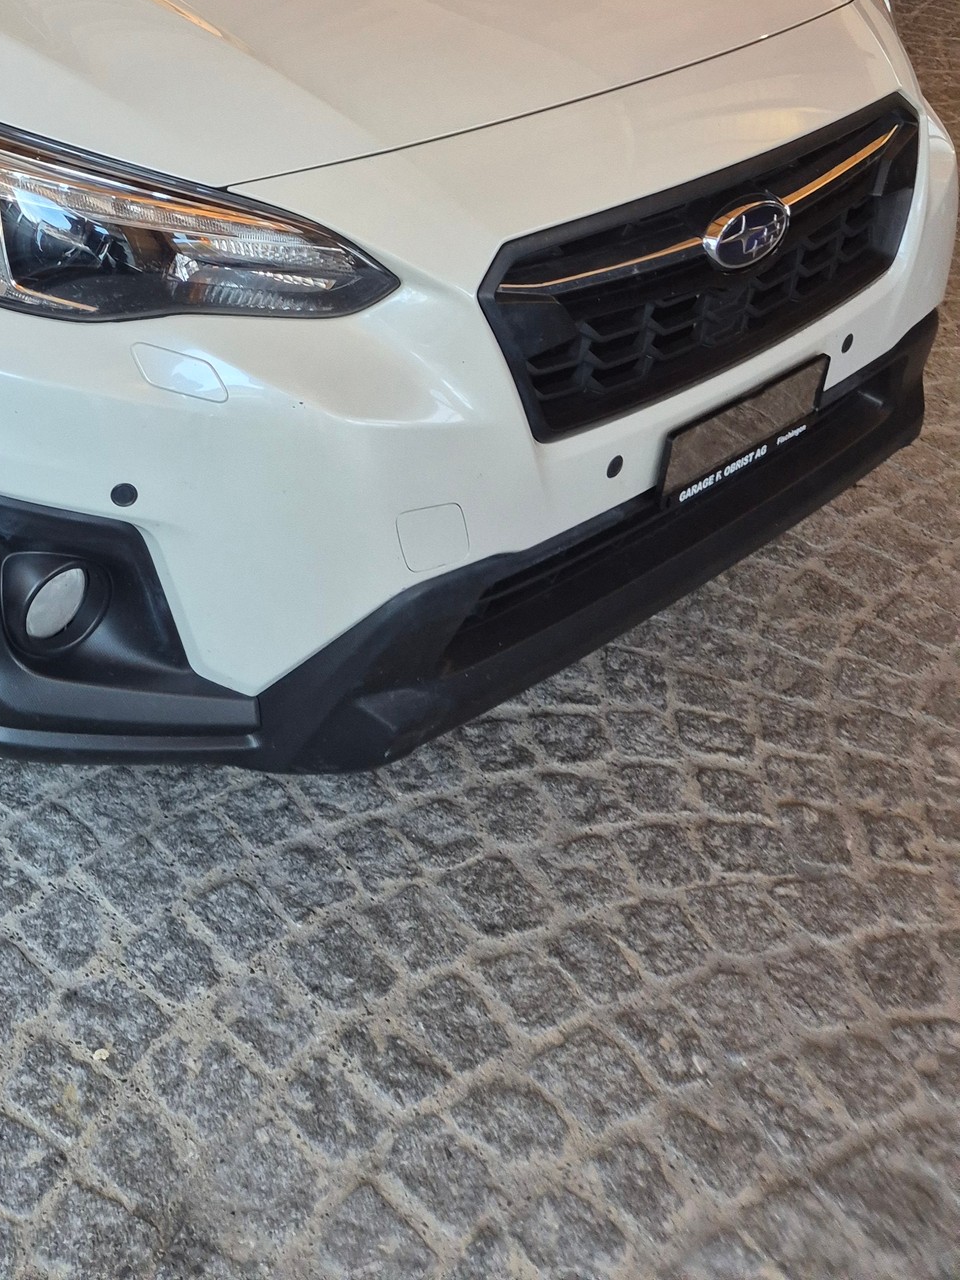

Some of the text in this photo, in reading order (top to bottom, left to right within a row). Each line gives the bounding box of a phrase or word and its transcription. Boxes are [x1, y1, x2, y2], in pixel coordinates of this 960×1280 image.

[679, 474, 714, 502] GARAGE
[724, 452, 754, 476] OBRIST
[755, 445, 767, 459] AG
